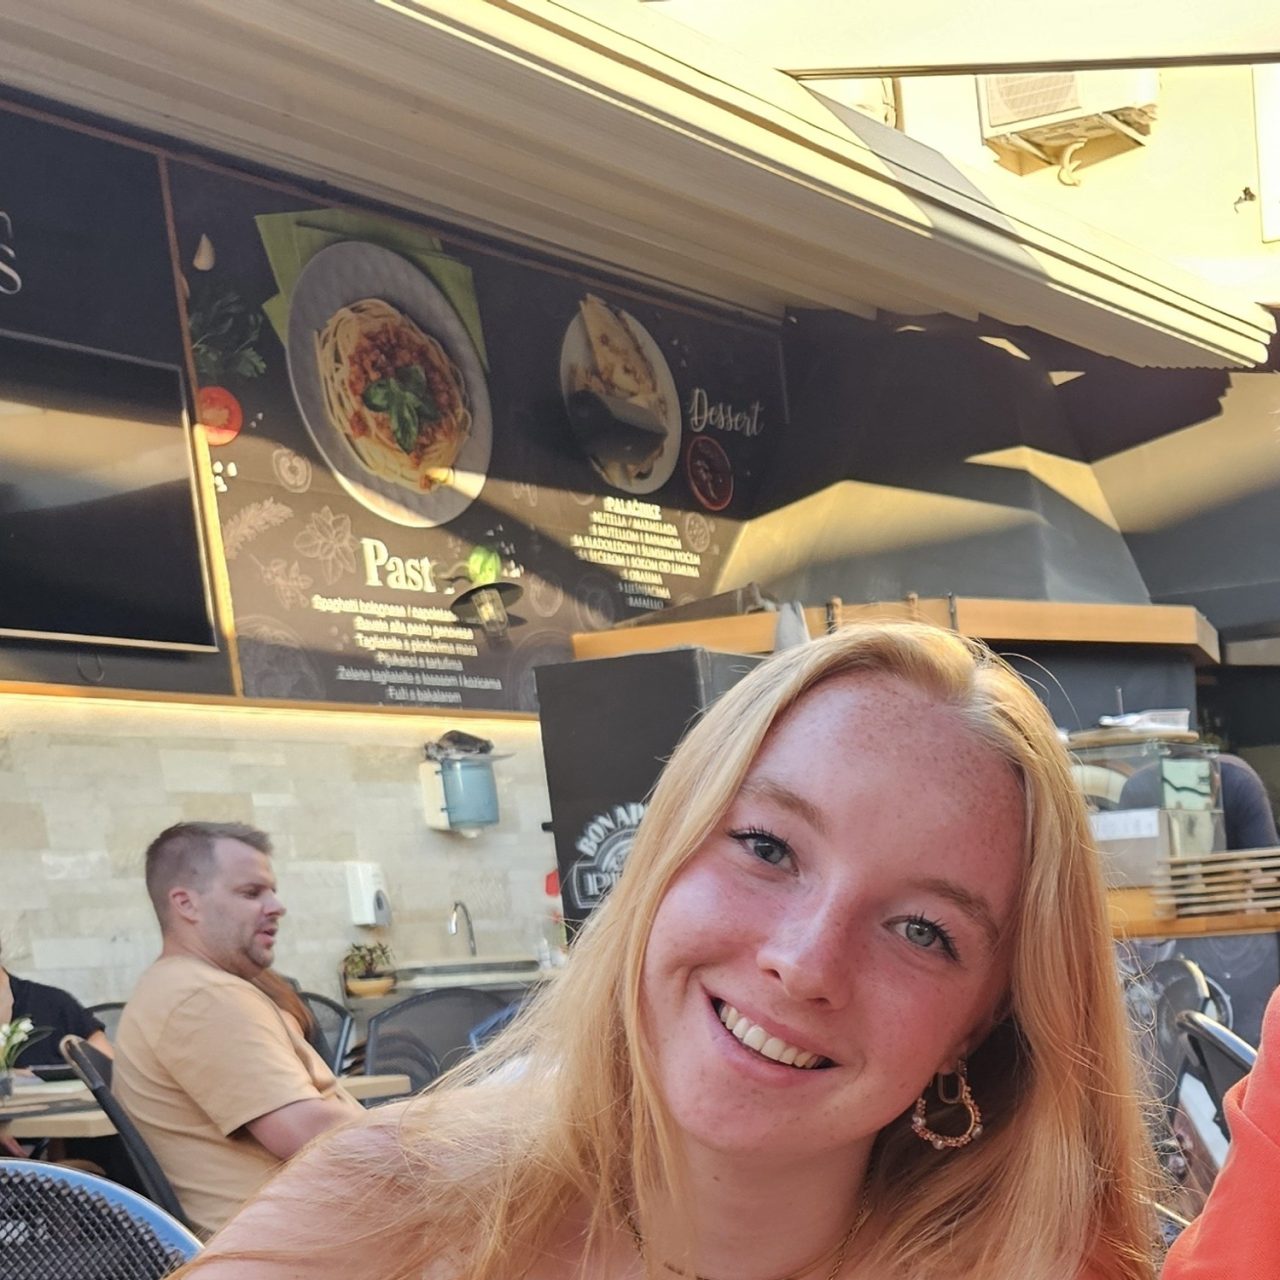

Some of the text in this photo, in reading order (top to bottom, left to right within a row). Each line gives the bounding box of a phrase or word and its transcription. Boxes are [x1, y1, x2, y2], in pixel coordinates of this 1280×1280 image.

[688, 387, 765, 437] Dessert
[361, 538, 455, 594] Past
[577, 812, 616, 857] BON
